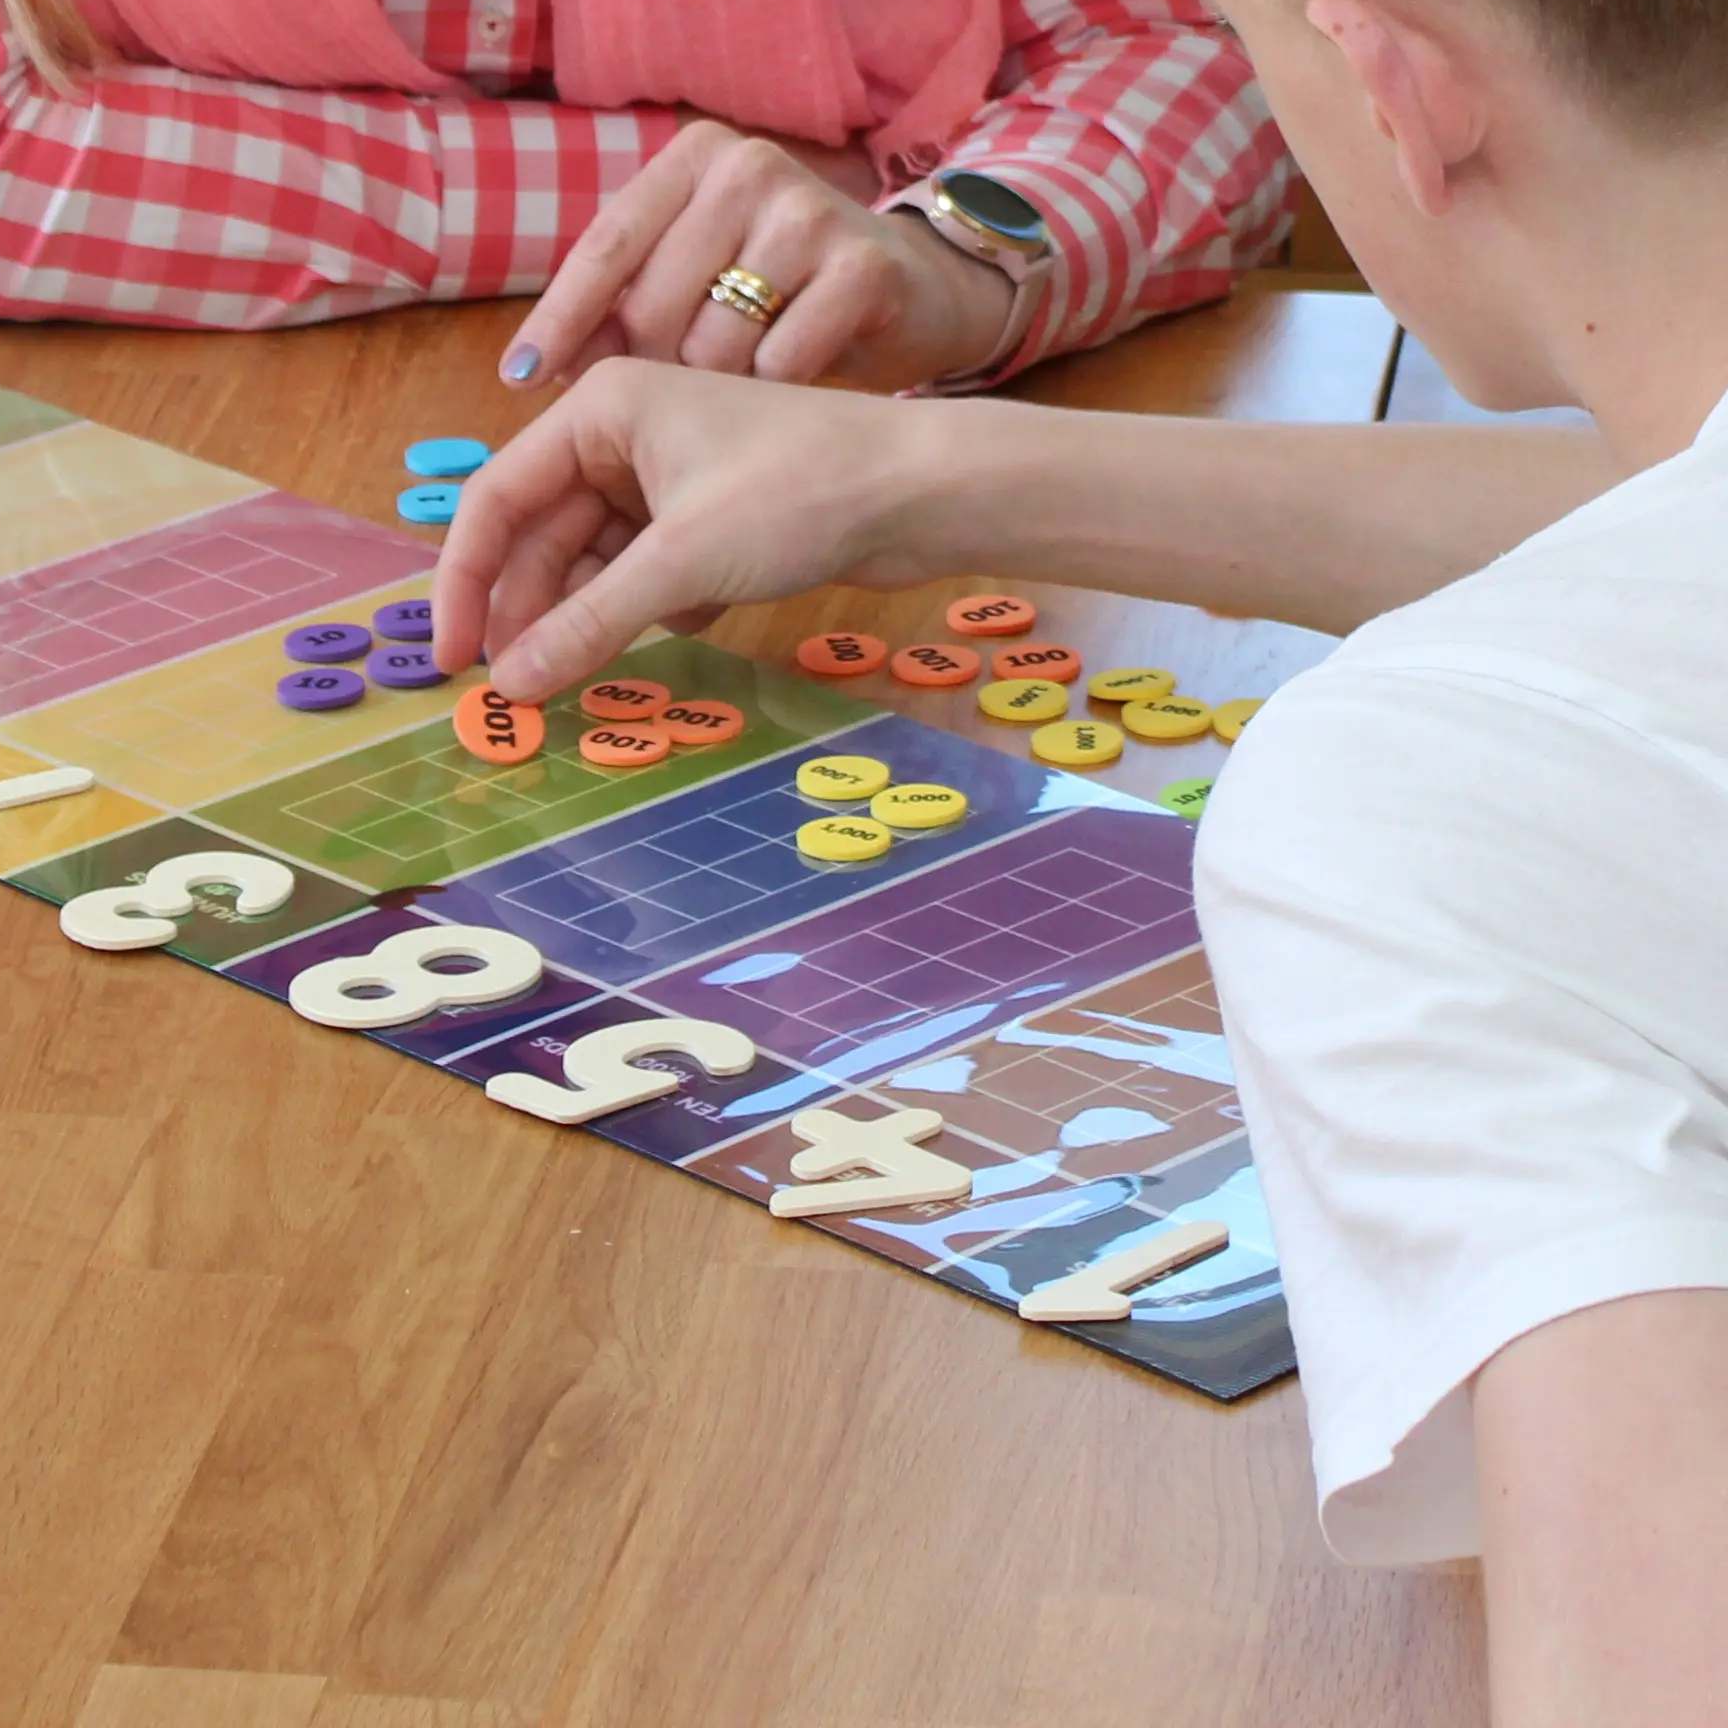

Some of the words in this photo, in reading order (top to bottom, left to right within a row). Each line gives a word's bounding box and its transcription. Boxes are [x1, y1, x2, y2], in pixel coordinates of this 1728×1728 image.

[962, 600, 1021, 622] 100
[305, 630, 346, 646] 10
[826, 636, 865, 662] 100
[387, 654, 428, 667] 10
[908, 647, 961, 672] 100
[1004, 649, 1070, 668] 100
[294, 676, 339, 690] 10
[591, 684, 655, 705] 100
[482, 691, 516, 748] 100
[662, 707, 730, 729] 100
[1144, 702, 1202, 717] 1,000
[589, 731, 656, 752] 100
[889, 794, 952, 803] 1,000
[821, 823, 878, 841] 1,000
[59, 852, 296, 952] 3
[289, 924, 544, 1030] 8
[485, 1017, 756, 1125] 5
[674, 1096, 725, 1124] TEN
[769, 1106, 974, 1219] 4
